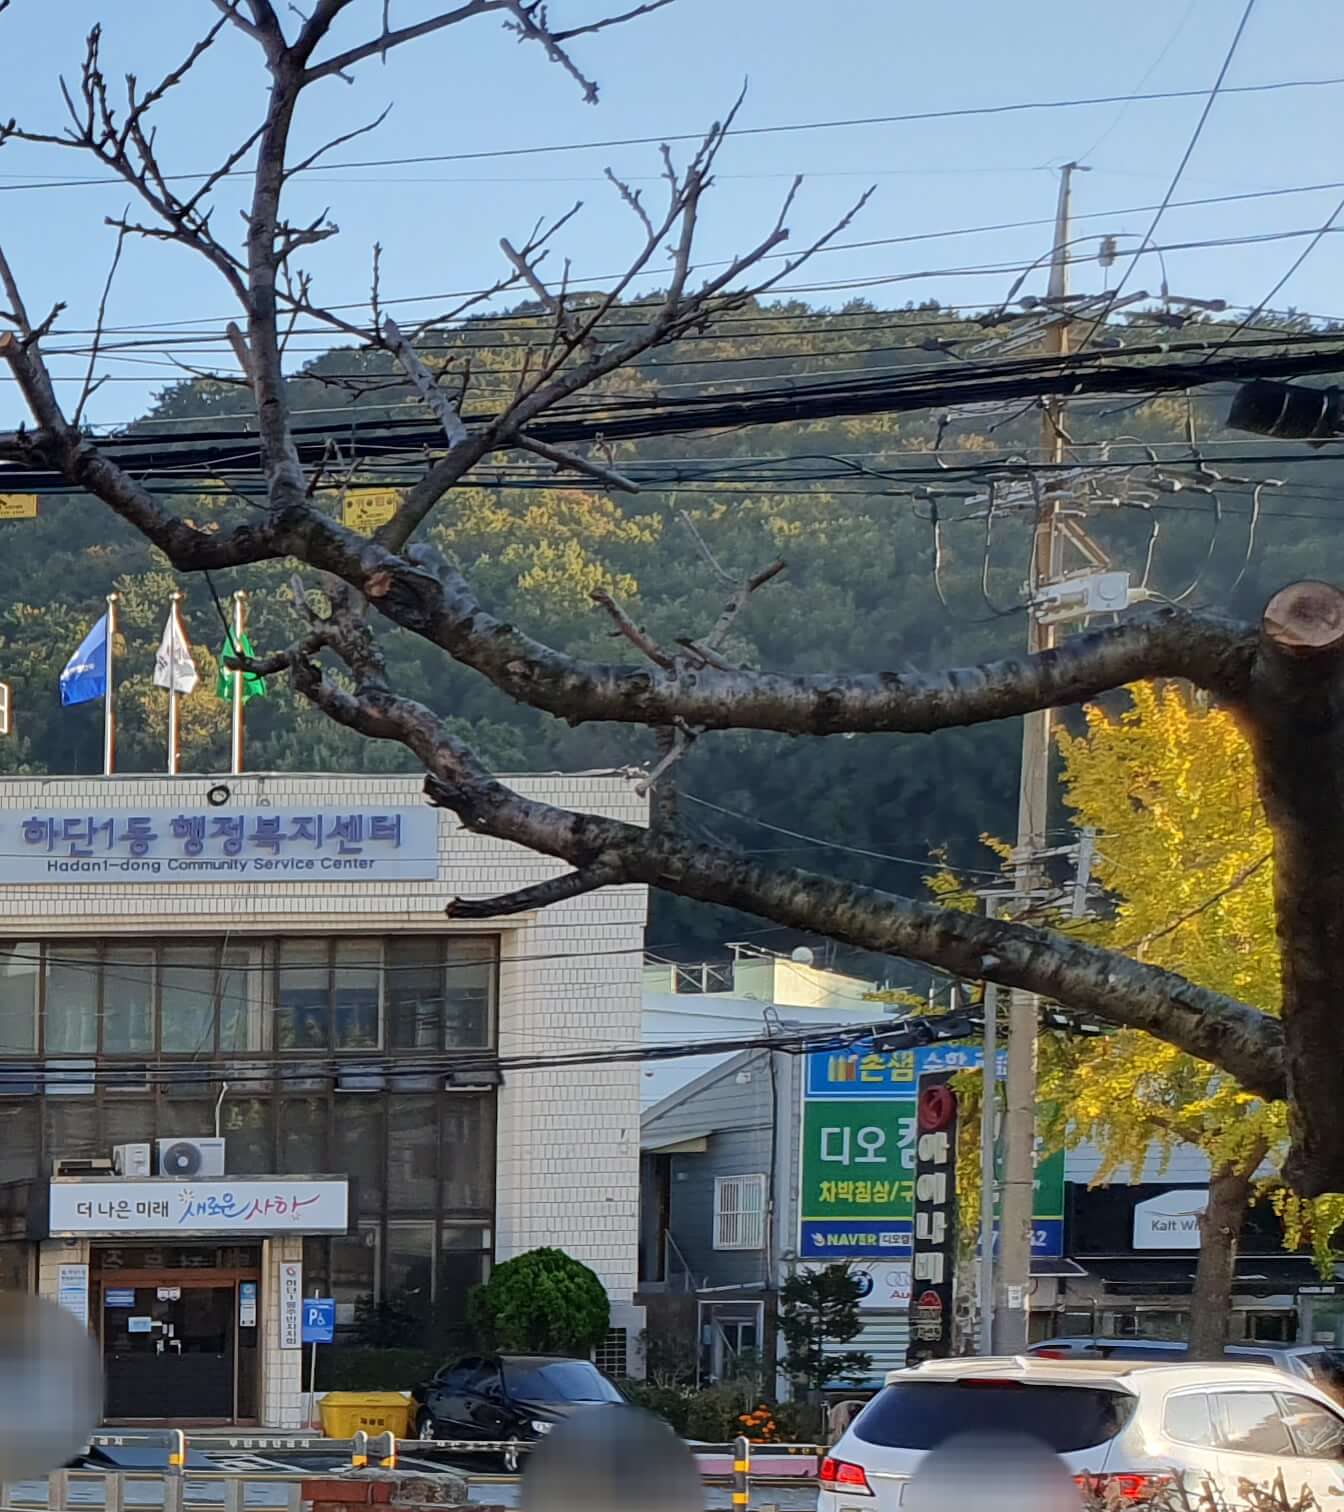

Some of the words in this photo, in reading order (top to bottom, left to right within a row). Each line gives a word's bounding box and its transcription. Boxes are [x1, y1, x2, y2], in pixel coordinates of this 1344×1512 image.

[21, 815, 159, 857] 하단1동
[170, 812, 403, 857] 행정복지센터
[47, 857, 161, 874] Hadan1-dong
[167, 857, 249, 874] Community
[254, 856, 315, 872] Service
[320, 855, 376, 871] Center
[820, 1125, 887, 1166] 디오
[76, 1202, 93, 1218] 더
[98, 1201, 132, 1219] 나은
[136, 1200, 169, 1218] 미래
[1151, 1218, 1177, 1231] Kalt
[827, 1233, 877, 1247] NAVER
[308, 1308, 318, 1326] P
